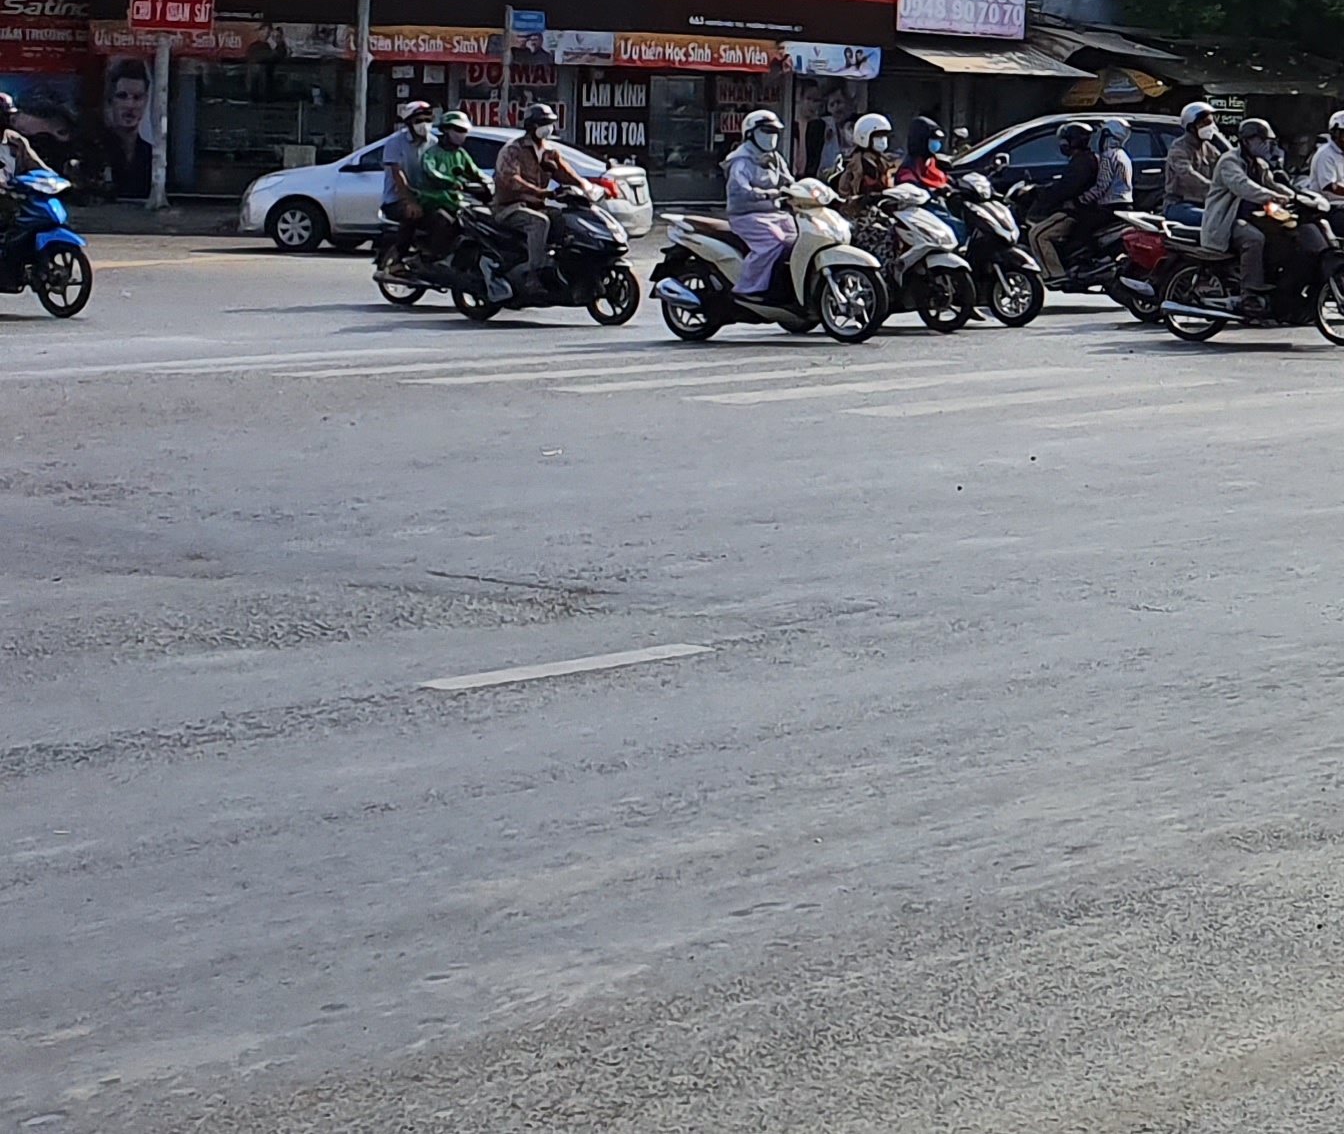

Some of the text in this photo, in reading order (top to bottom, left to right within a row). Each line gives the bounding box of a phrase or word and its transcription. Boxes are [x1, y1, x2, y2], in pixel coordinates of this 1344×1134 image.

[665, 42, 688, 64] Học
[688, 41, 712, 64] Sinh
[719, 43, 743, 65] Sinh
[744, 45, 768, 66] Viên
[613, 77, 647, 108] KÍNH
[584, 120, 646, 147] THEO TOA
